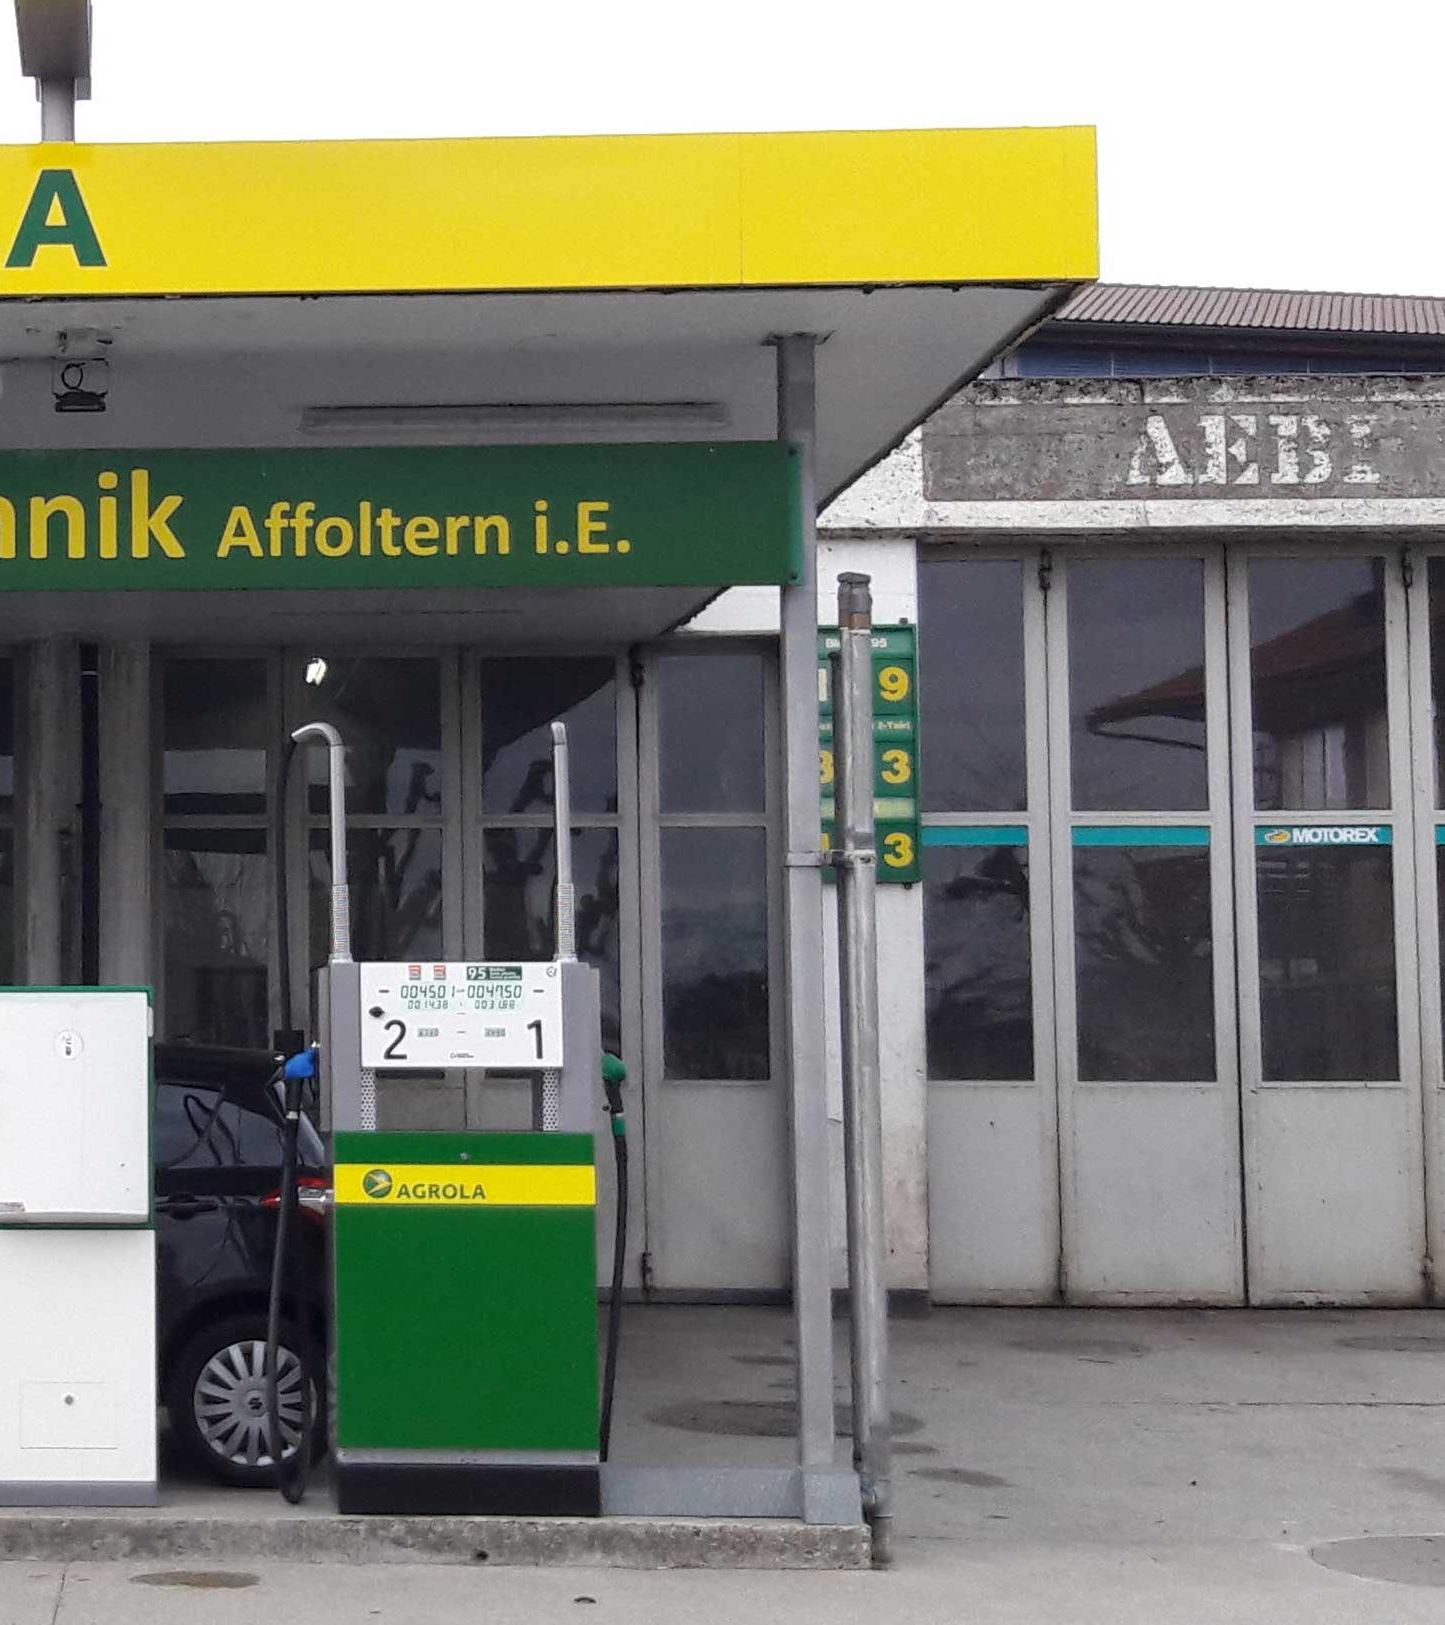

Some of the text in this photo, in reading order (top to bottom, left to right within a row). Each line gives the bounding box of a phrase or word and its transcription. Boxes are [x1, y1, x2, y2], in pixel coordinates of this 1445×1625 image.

[216, 499, 512, 558] Affoltern
[533, 499, 632, 555] i.E.
[878, 666, 910, 702] 9
[880, 748, 912, 785] 3
[883, 831, 915, 868] 3
[1292, 827, 1380, 844] MOTOREX
[467, 967, 487, 980] 95
[383, 1019, 408, 1060] 2
[526, 1019, 544, 1060] 1
[396, 1183, 486, 1200] AGROLA
